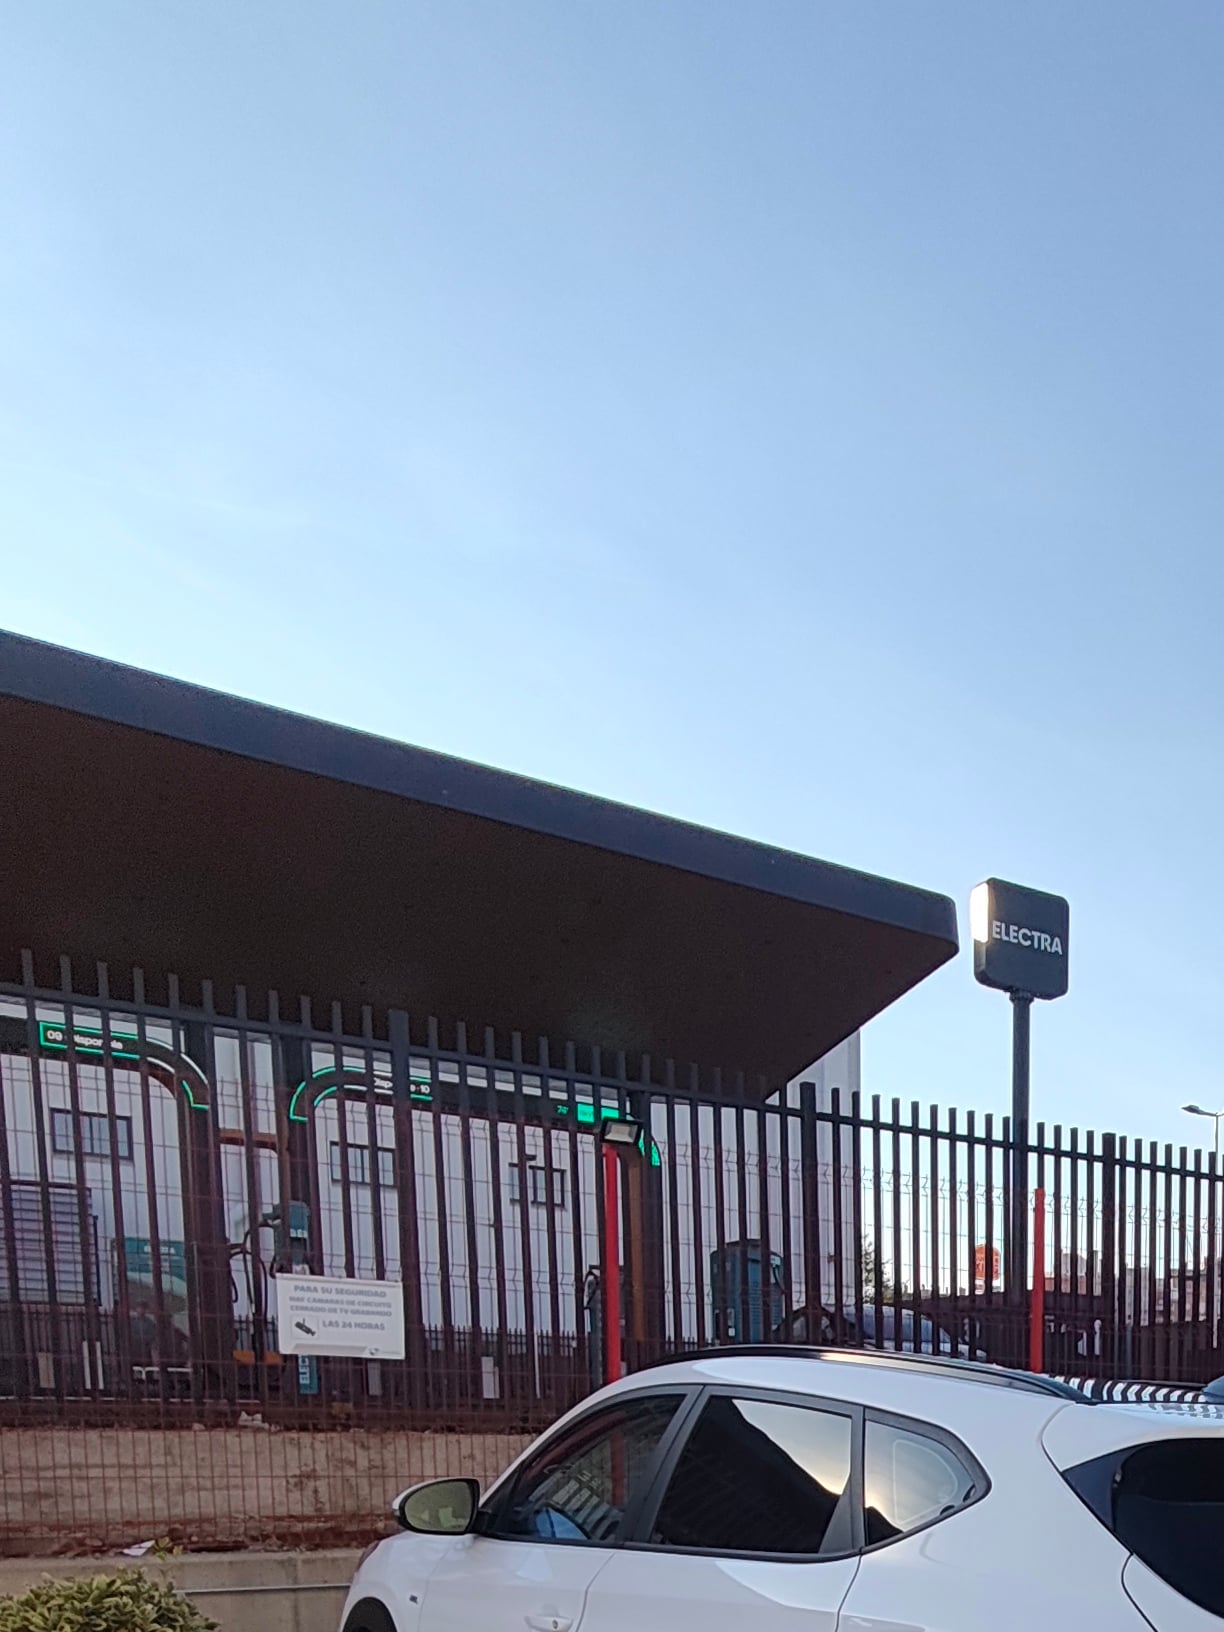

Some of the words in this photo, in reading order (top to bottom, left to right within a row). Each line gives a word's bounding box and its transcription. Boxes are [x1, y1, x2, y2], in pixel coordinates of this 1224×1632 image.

[992, 920, 1063, 955] ELECTRA
[46, 1030, 63, 1041] 09
[294, 1285, 319, 1294] PARA
[320, 1286, 333, 1295] SU
[335, 1287, 387, 1298] SEGURIDAD
[307, 1296, 345, 1305] CAMARAS
[357, 1300, 392, 1309] CIRCUITO
[290, 1304, 327, 1313] CERRADO
[328, 1306, 338, 1314] DE
[339, 1307, 349, 1315] TV
[350, 1308, 393, 1317] GRABANDO
[322, 1320, 340, 1328] LAS
[341, 1321, 353, 1329] 24
[354, 1321, 385, 1331] HORAS
